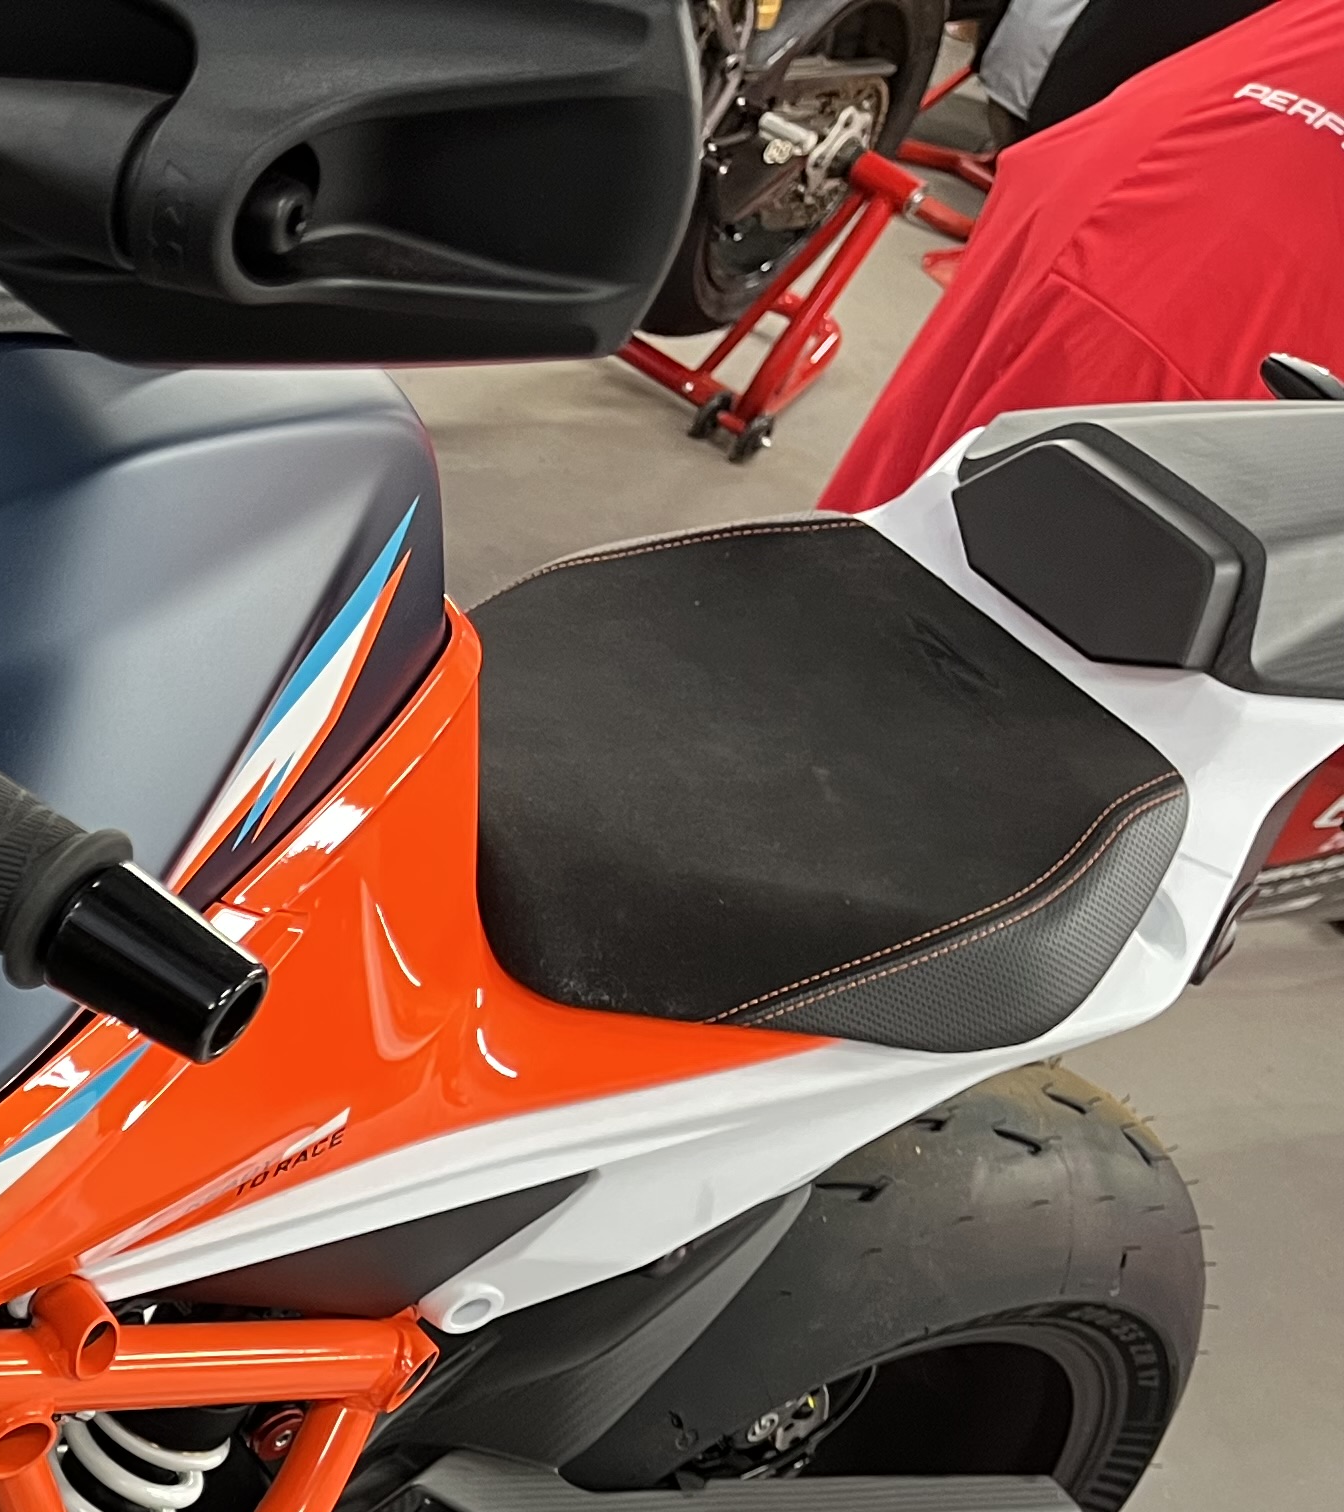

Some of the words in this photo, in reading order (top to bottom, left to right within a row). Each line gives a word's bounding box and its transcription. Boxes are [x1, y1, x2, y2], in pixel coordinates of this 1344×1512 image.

[1233, 82, 1344, 151] PERF
[237, 1171, 269, 1196] TO
[273, 1127, 346, 1177] RACE
